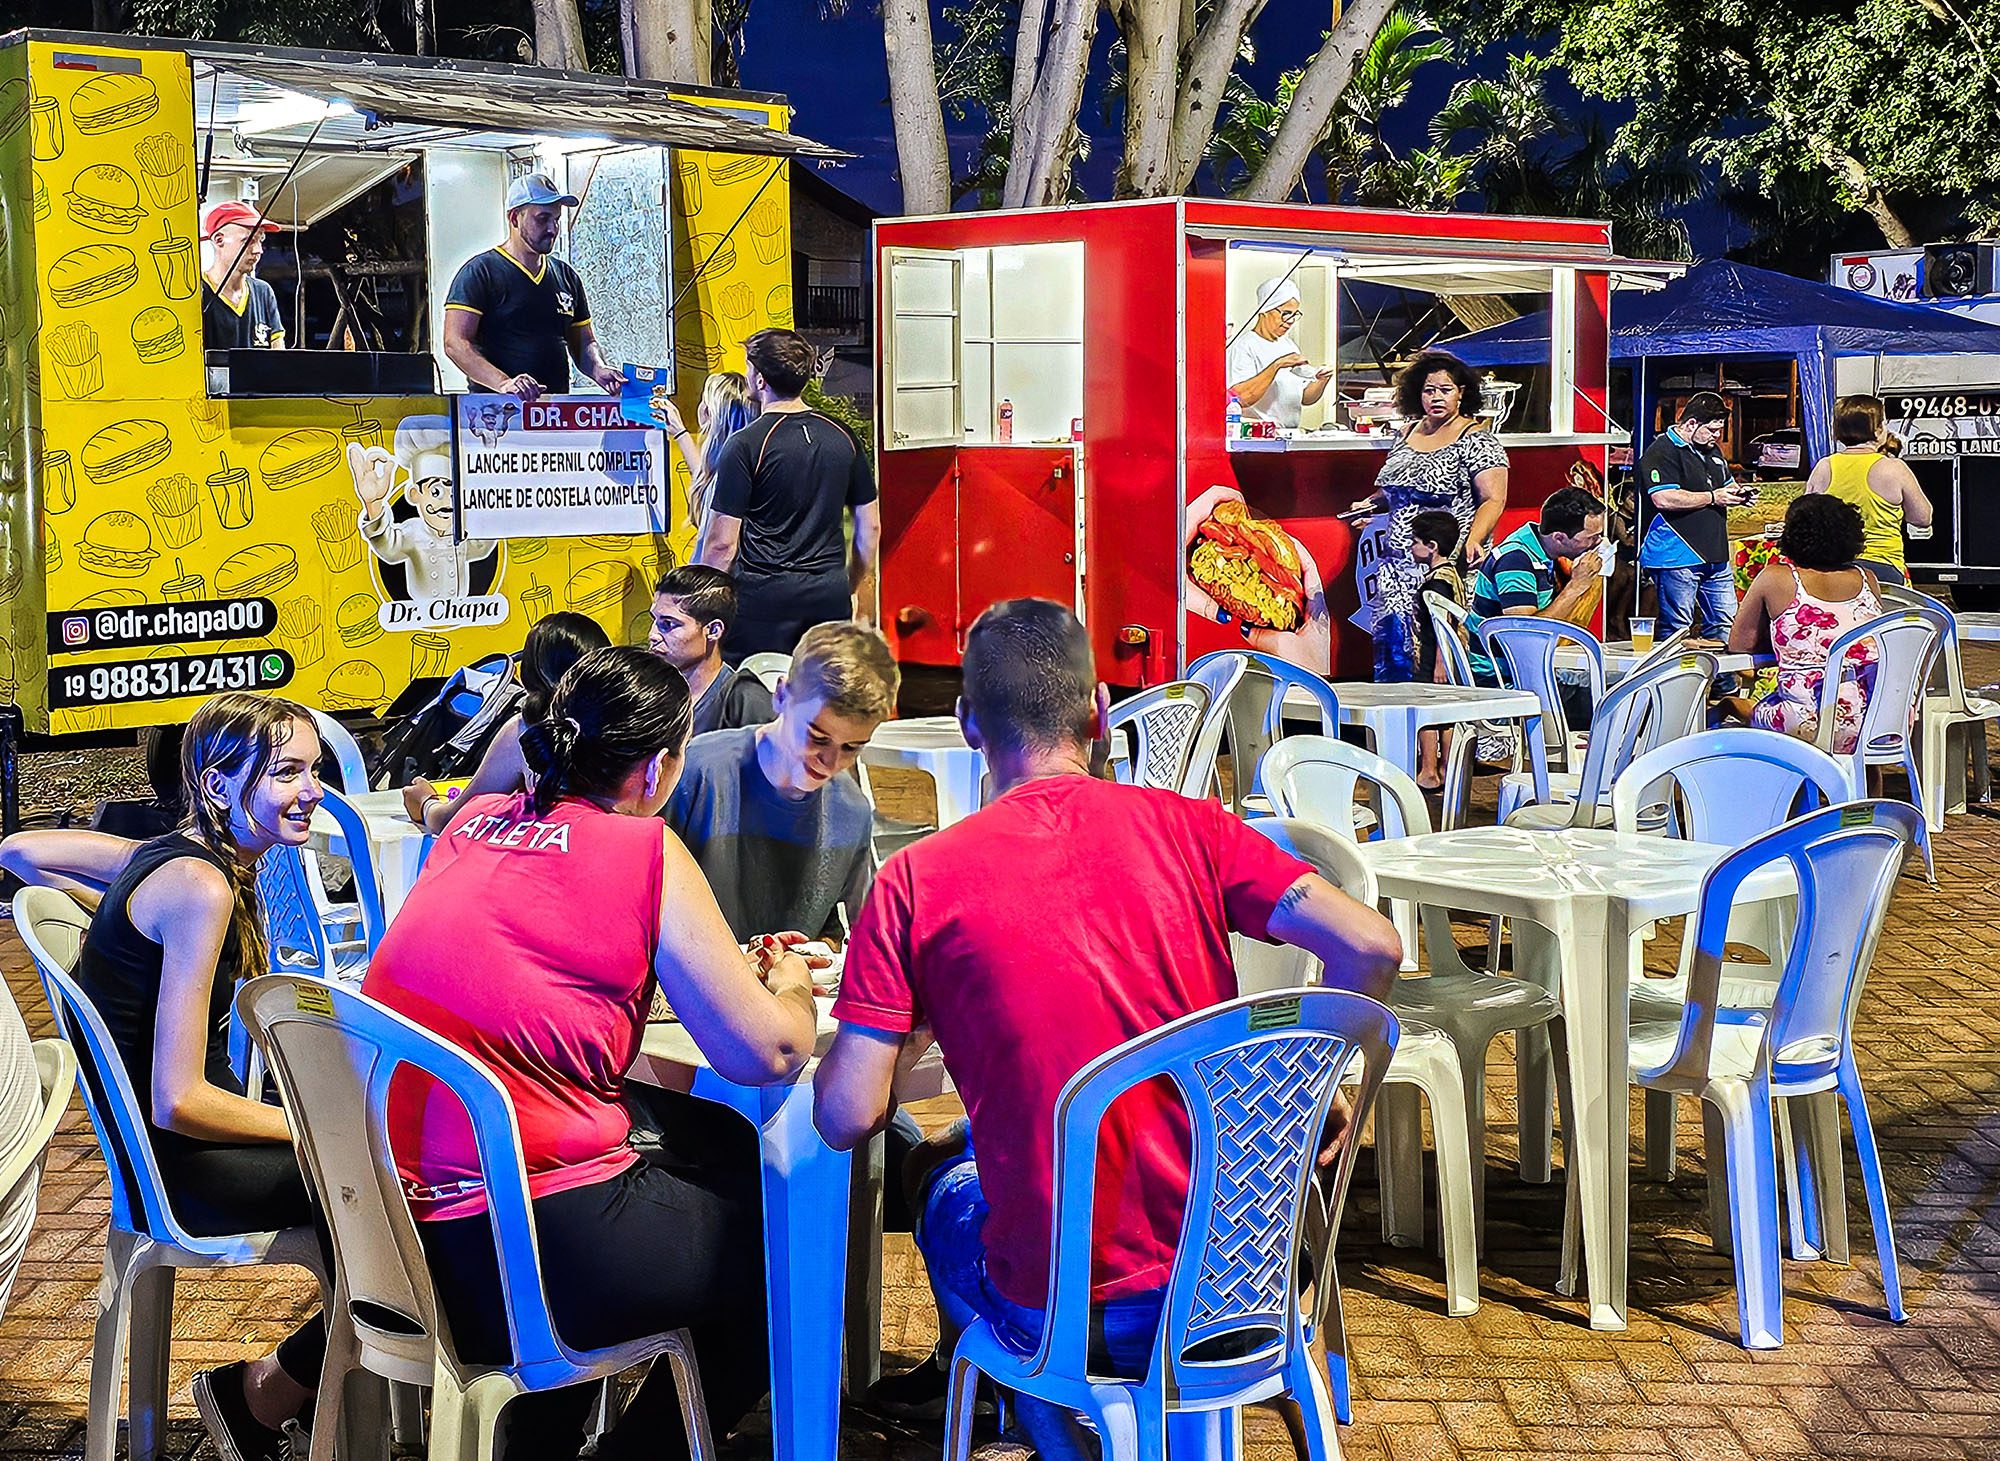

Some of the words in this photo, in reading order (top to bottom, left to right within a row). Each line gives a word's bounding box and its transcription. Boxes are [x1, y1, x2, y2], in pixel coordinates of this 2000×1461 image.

[530, 406, 568, 427] DR.
[574, 406, 641, 427] CHA
[1909, 438, 1957, 455] ERÓIS
[467, 453, 518, 474] LANCHE
[522, 452, 538, 473] DE
[541, 452, 585, 473] PERNIL
[588, 451, 652, 472] COMPLETO
[463, 488, 513, 509] LANCHE
[516, 488, 533, 508] DE
[536, 486, 592, 507] COSTELA
[594, 484, 658, 506] COMPLETO
[95, 601, 264, 640] @dr.chapa00
[388, 602, 422, 624] Dr.
[429, 599, 499, 622] Chapa
[63, 675, 85, 698] 19
[89, 655, 256, 700] 98831.2431
[452, 813, 572, 853] ATLETA
